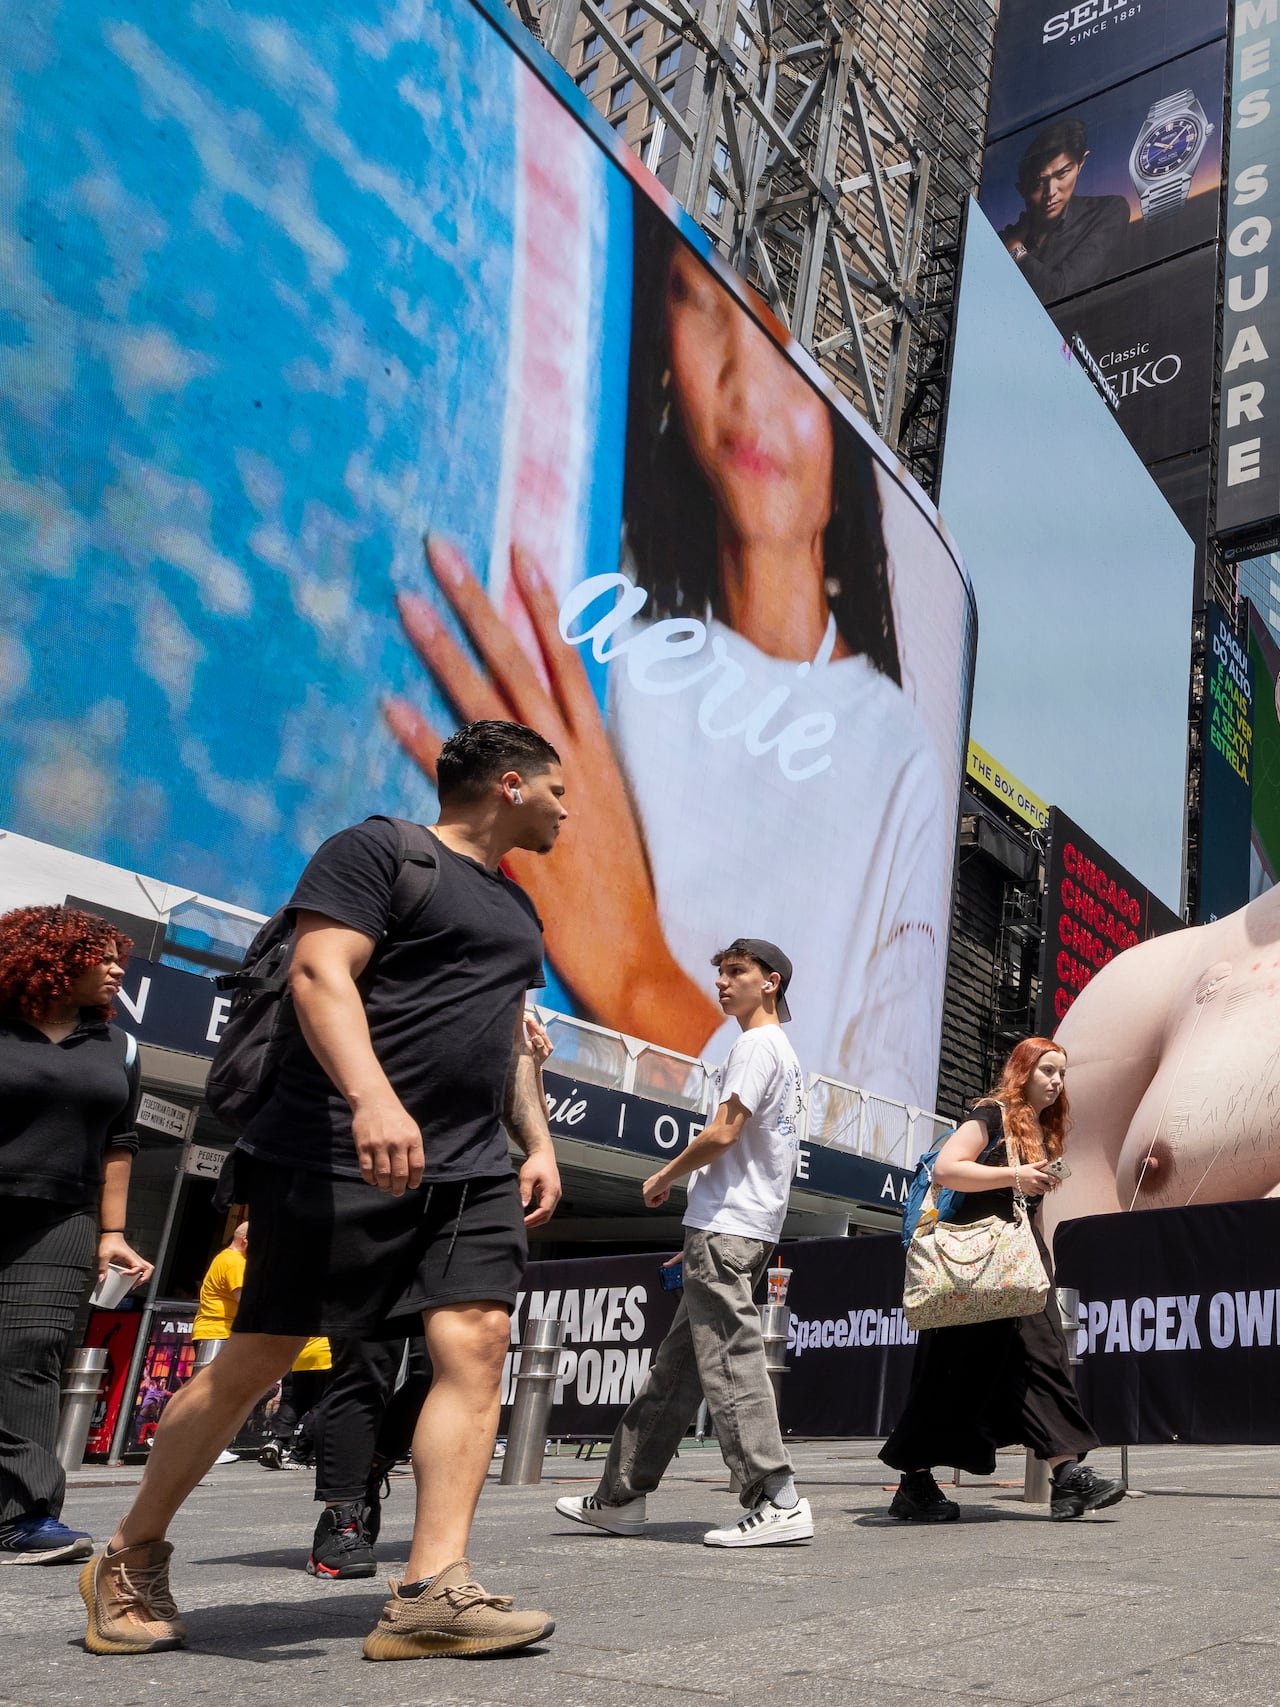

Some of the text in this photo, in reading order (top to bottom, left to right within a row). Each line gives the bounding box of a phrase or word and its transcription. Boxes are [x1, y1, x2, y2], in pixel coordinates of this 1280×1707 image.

[1043, 0, 1134, 44] SEI
[1069, 5, 1142, 46] SINCE 1881
[1224, 163, 1272, 488] SQUARE
[1099, 342, 1149, 369] Classic
[1104, 354, 1181, 398] IKO
[1212, 634, 1228, 666] DO
[1219, 620, 1248, 675] DAQUI
[558, 572, 837, 782] aerie
[1224, 674, 1248, 717] MAIS
[1212, 705, 1249, 763] A SEXTA
[1236, 709, 1253, 745] VER
[972, 754, 1050, 828] THE BOX OFFICE
[1063, 842, 1141, 927] CHICAGO
[527, 1285, 648, 1343] MAKES
[553, 1347, 653, 1406] PORN
